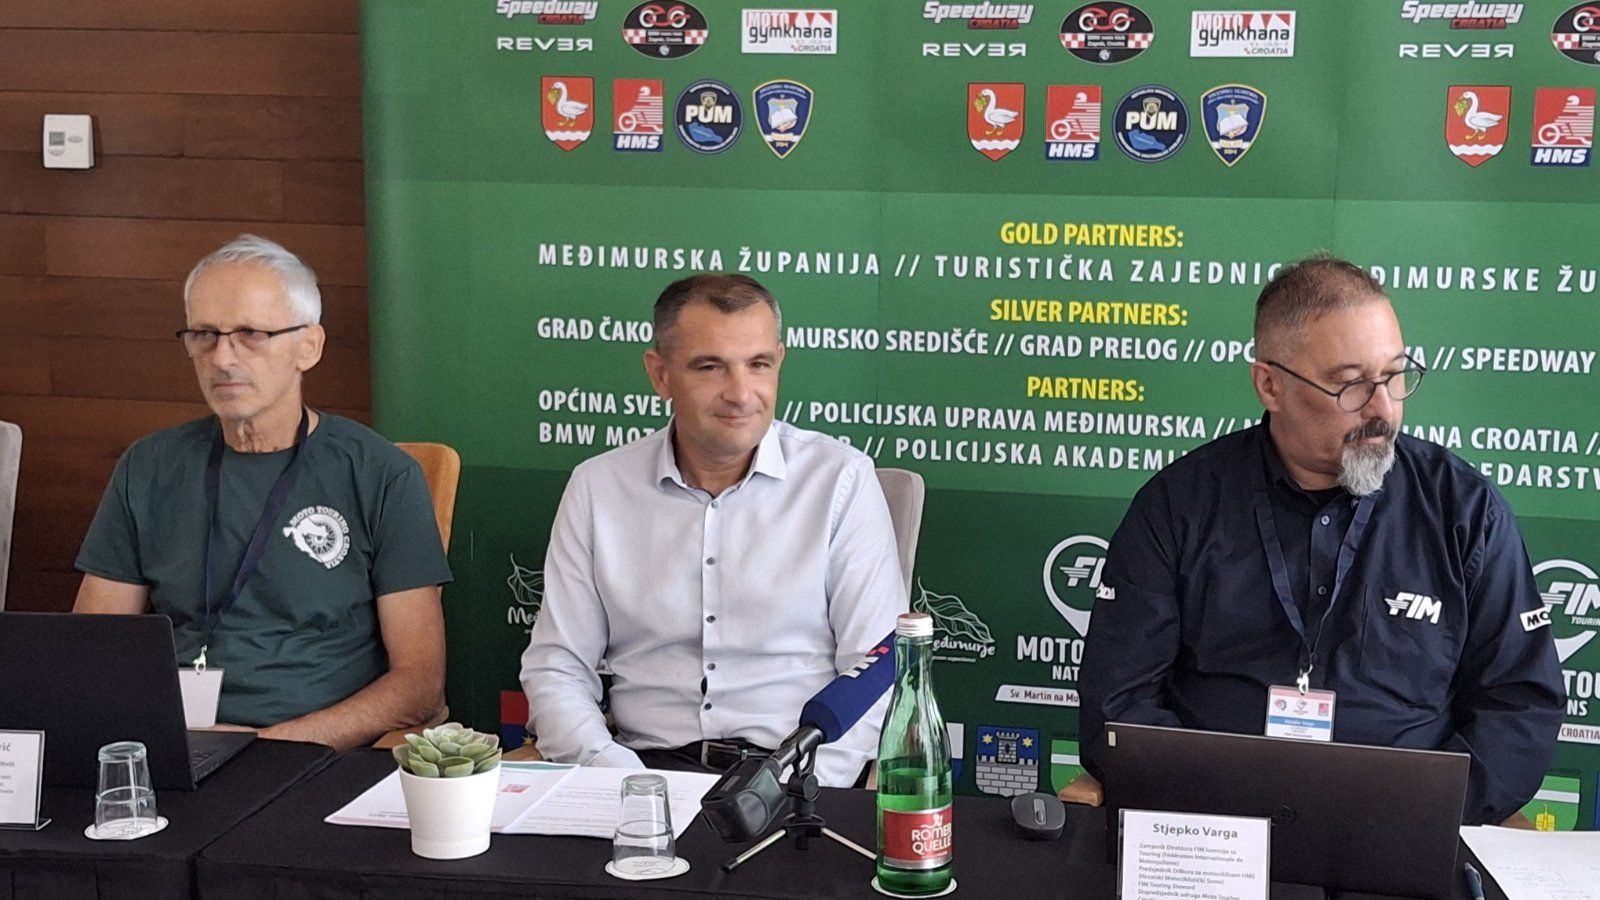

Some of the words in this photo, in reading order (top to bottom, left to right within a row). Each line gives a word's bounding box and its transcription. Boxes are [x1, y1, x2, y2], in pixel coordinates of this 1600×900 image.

[496, 0, 598, 23] Speedway
[748, 12, 790, 28] MOTO
[923, 1, 1035, 28] Speedway
[1401, 0, 1524, 24] Speedway
[968, 18, 1019, 29] CROATIA
[1198, 14, 1244, 30] MOTO
[749, 24, 832, 43] gymkhana
[1198, 25, 1290, 47] gymkhana
[1251, 47, 1288, 55] CROATIA
[685, 105, 732, 123] PUM
[1125, 111, 1177, 131] PUM
[616, 135, 660, 150] HMS
[1049, 144, 1095, 158] HMS
[1534, 149, 1587, 164] HMS
[1000, 222, 1058, 245] GOLD
[1064, 223, 1184, 248] PARTNERS:
[538, 243, 724, 271] MEĐIMURSKA
[738, 246, 880, 275] ŽUPANIJA
[935, 254, 1114, 282] TURISTIČKA
[1130, 260, 1282, 285] ZAJEDNIC
[1370, 264, 1540, 292] ĐIMURSKE
[1557, 265, 1597, 293] ŽU
[990, 299, 1062, 323] SILVER
[1068, 301, 1188, 326] PARTNERS:
[537, 317, 594, 340] GRAD
[599, 316, 653, 343] ČAKO
[786, 326, 880, 351] MURSKO
[885, 327, 988, 355] SREDIŠĆE
[1020, 334, 1082, 358] GRAD
[1089, 336, 1177, 361] PRELOG
[1210, 338, 1255, 363] OPĆ
[1461, 347, 1596, 374] SPEEDWAY
[1027, 376, 1145, 401] PARTNERS:
[538, 387, 617, 415] OPĆINA
[624, 393, 673, 417] SVET
[810, 401, 936, 427] POLICIJSKA
[945, 406, 1036, 432] UPRAVA
[1044, 410, 1206, 439] MEĐIMURSKA
[1402, 424, 1462, 449] ANA
[1471, 426, 1578, 453] CROATIA
[538, 422, 596, 446] BMW
[605, 425, 656, 446] MOT
[895, 437, 1042, 465] POLICIJSKA
[1053, 444, 1188, 471] AKADEMI
[1480, 462, 1600, 490] EDARST
[1060, 556, 1106, 588] FI
[508, 606, 540, 625] Me
[1384, 591, 1443, 625] FIM
[1526, 611, 1550, 627] MO
[1571, 616, 1600, 626] TOURIN
[933, 635, 996, 658] eđimurje
[1017, 635, 1085, 665] MOTO
[1052, 665, 1080, 682] NAT
[1024, 689, 1051, 701] Martin
[1054, 694, 1063, 702] na
[1066, 692, 1079, 703] Mu
[1566, 698, 1588, 716] NS
[1153, 823, 1200, 837] Stjepko
[1202, 826, 1238, 840] Varga
